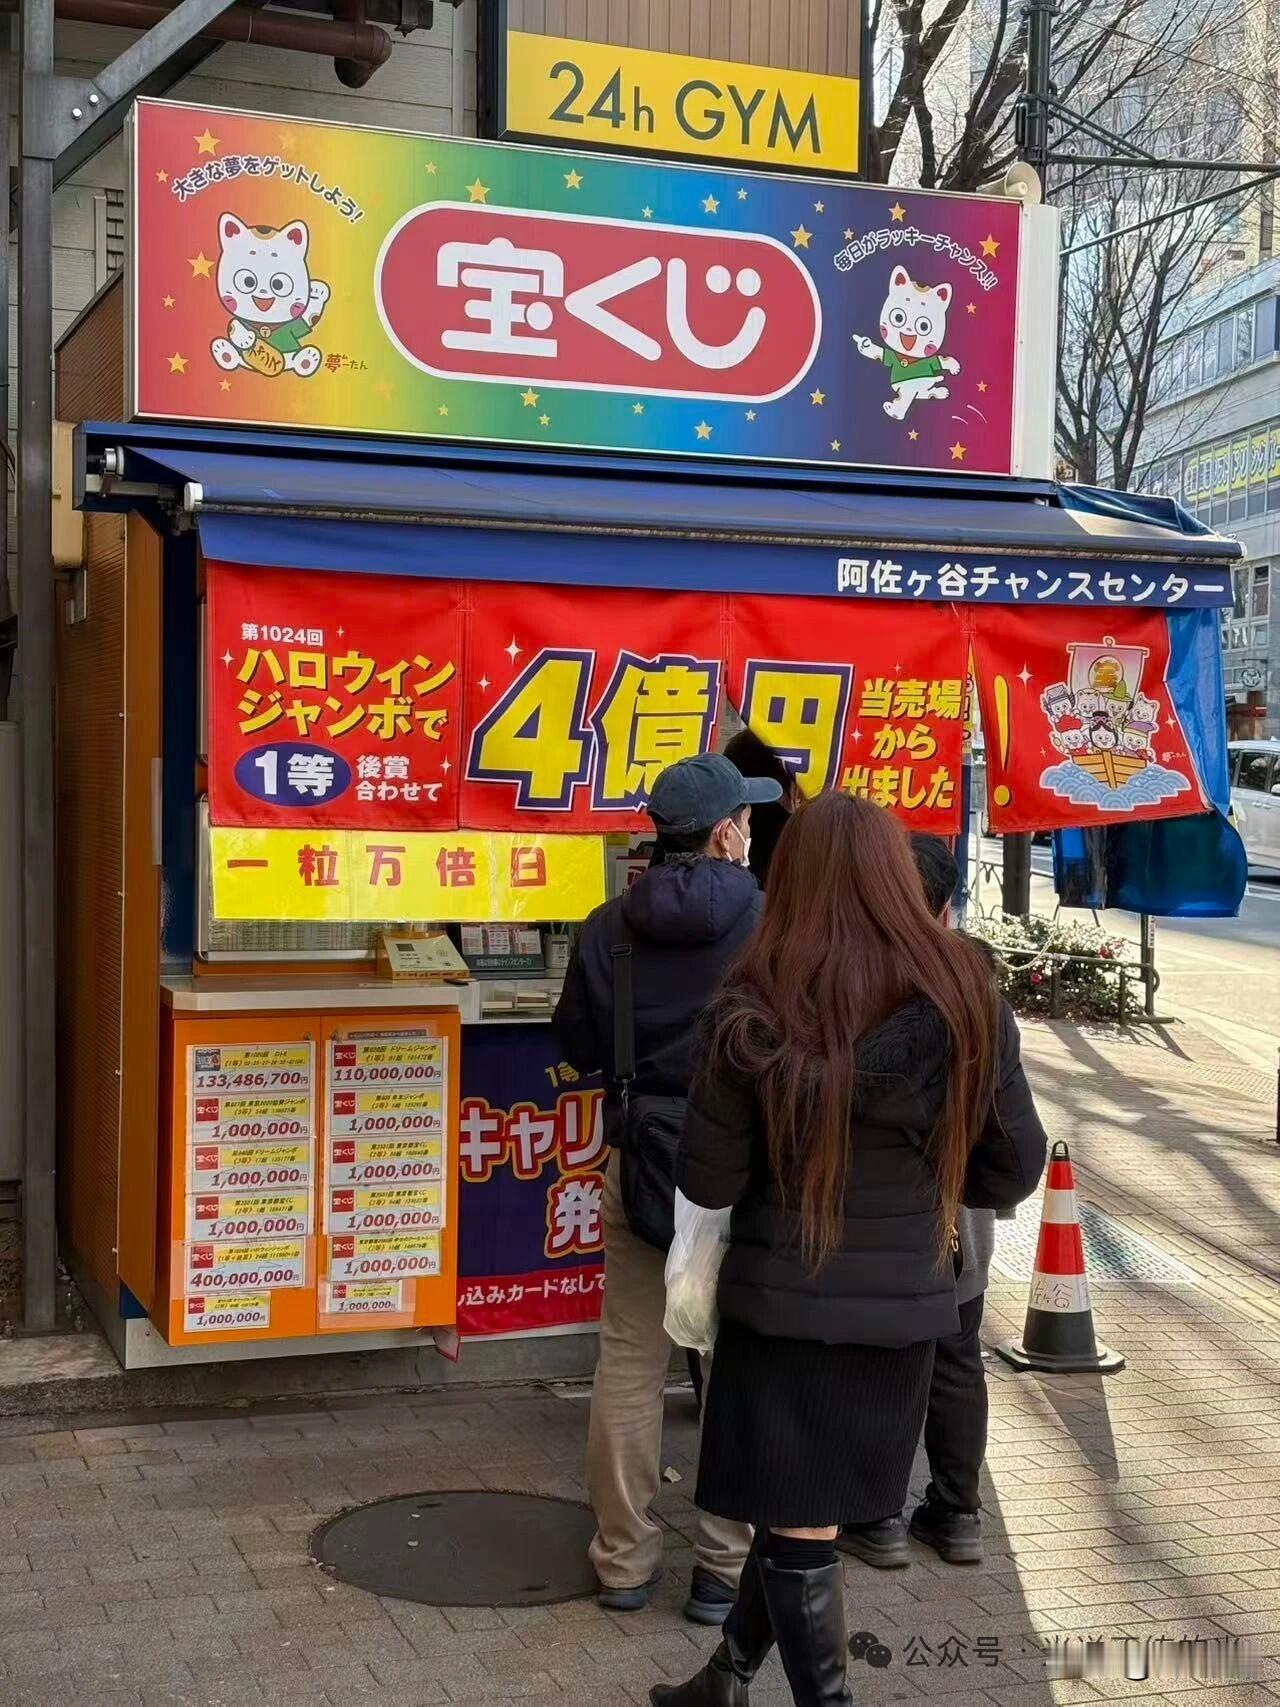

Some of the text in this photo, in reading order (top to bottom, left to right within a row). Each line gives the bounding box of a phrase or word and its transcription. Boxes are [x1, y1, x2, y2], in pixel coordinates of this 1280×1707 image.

[548, 61, 822, 154] 24h GYM
[436, 236, 767, 370] 宝くじ
[837, 558, 1226, 603] 阿佐ヶ谷チャンスセンター
[240, 622, 324, 646] 第1024回
[235, 648, 456, 697] ハロウィン
[857, 677, 962, 720] 当売場
[236, 689, 449, 742] ジャンボで
[870, 724, 937, 761] から
[254, 750, 336, 797] 1等
[357, 755, 409, 780] 後賞
[355, 780, 443, 802] 合わせて
[841, 764, 955, 810] 出ました
[226, 844, 548, 888] 一粒万倍日
[196, 1072, 308, 1089] 133,486,700円
[334, 1066, 441, 1083] 110,000,000円
[212, 1121, 307, 1139] 1,000,000円
[350, 1115, 440, 1133] 1,000,000円
[211, 1169, 307, 1188] 1,000,000円
[348, 1163, 440, 1181] 1,000,000円
[208, 1218, 304, 1237] 1,000,000円
[347, 1212, 439, 1230] 1,000,000円
[190, 1269, 300, 1287] 400,000,000円
[344, 1256, 436, 1276] 1,000,000円
[457, 1274, 606, 1308] 込みカードなし
